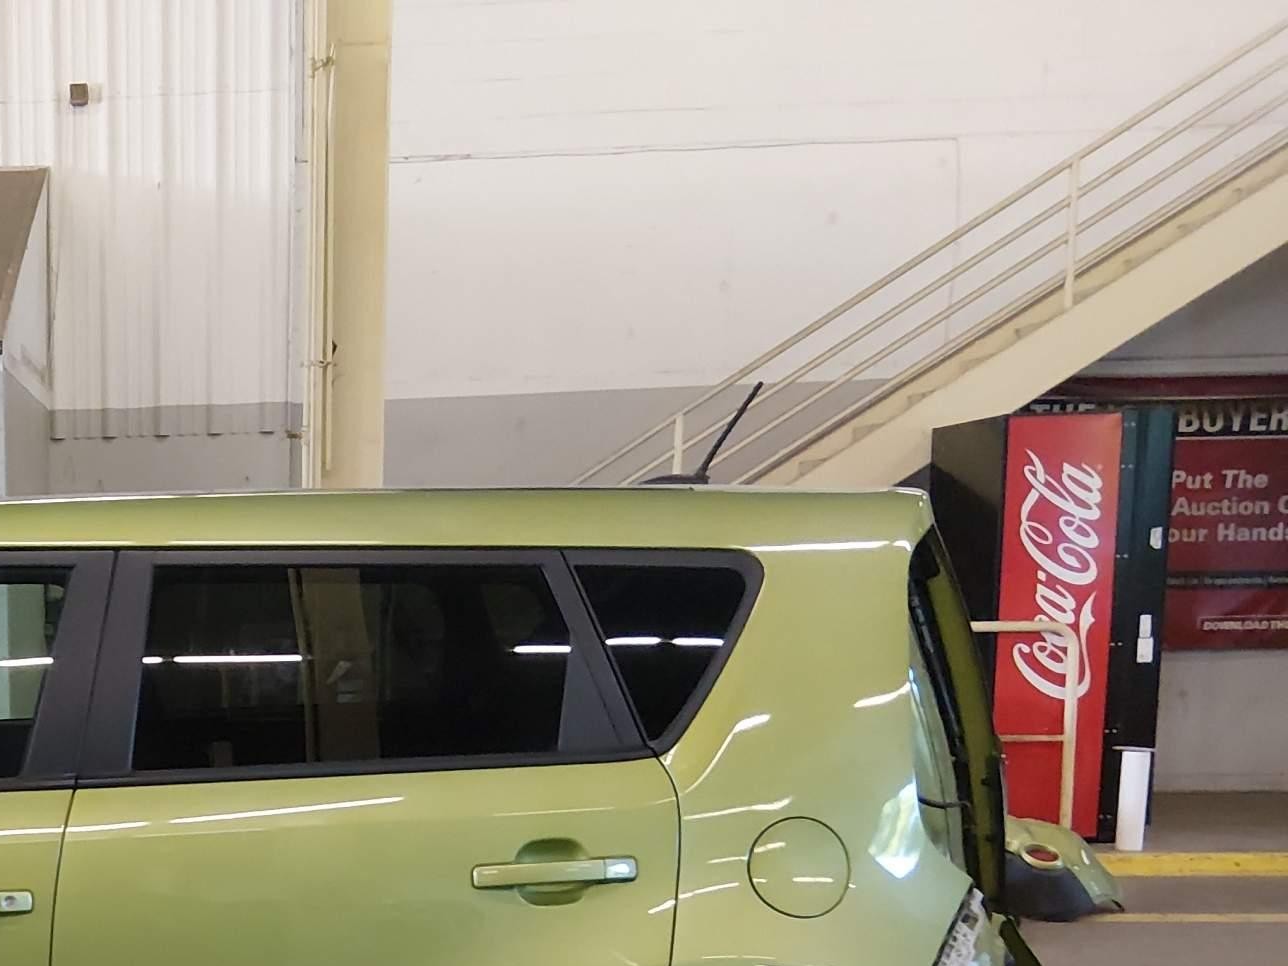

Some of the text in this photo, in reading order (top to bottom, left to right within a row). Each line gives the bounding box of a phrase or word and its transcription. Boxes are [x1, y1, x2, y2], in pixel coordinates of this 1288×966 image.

[1172, 469, 1269, 489] Put The
[1171, 496, 1270, 516] Auction
[1168, 527, 1208, 543] our
